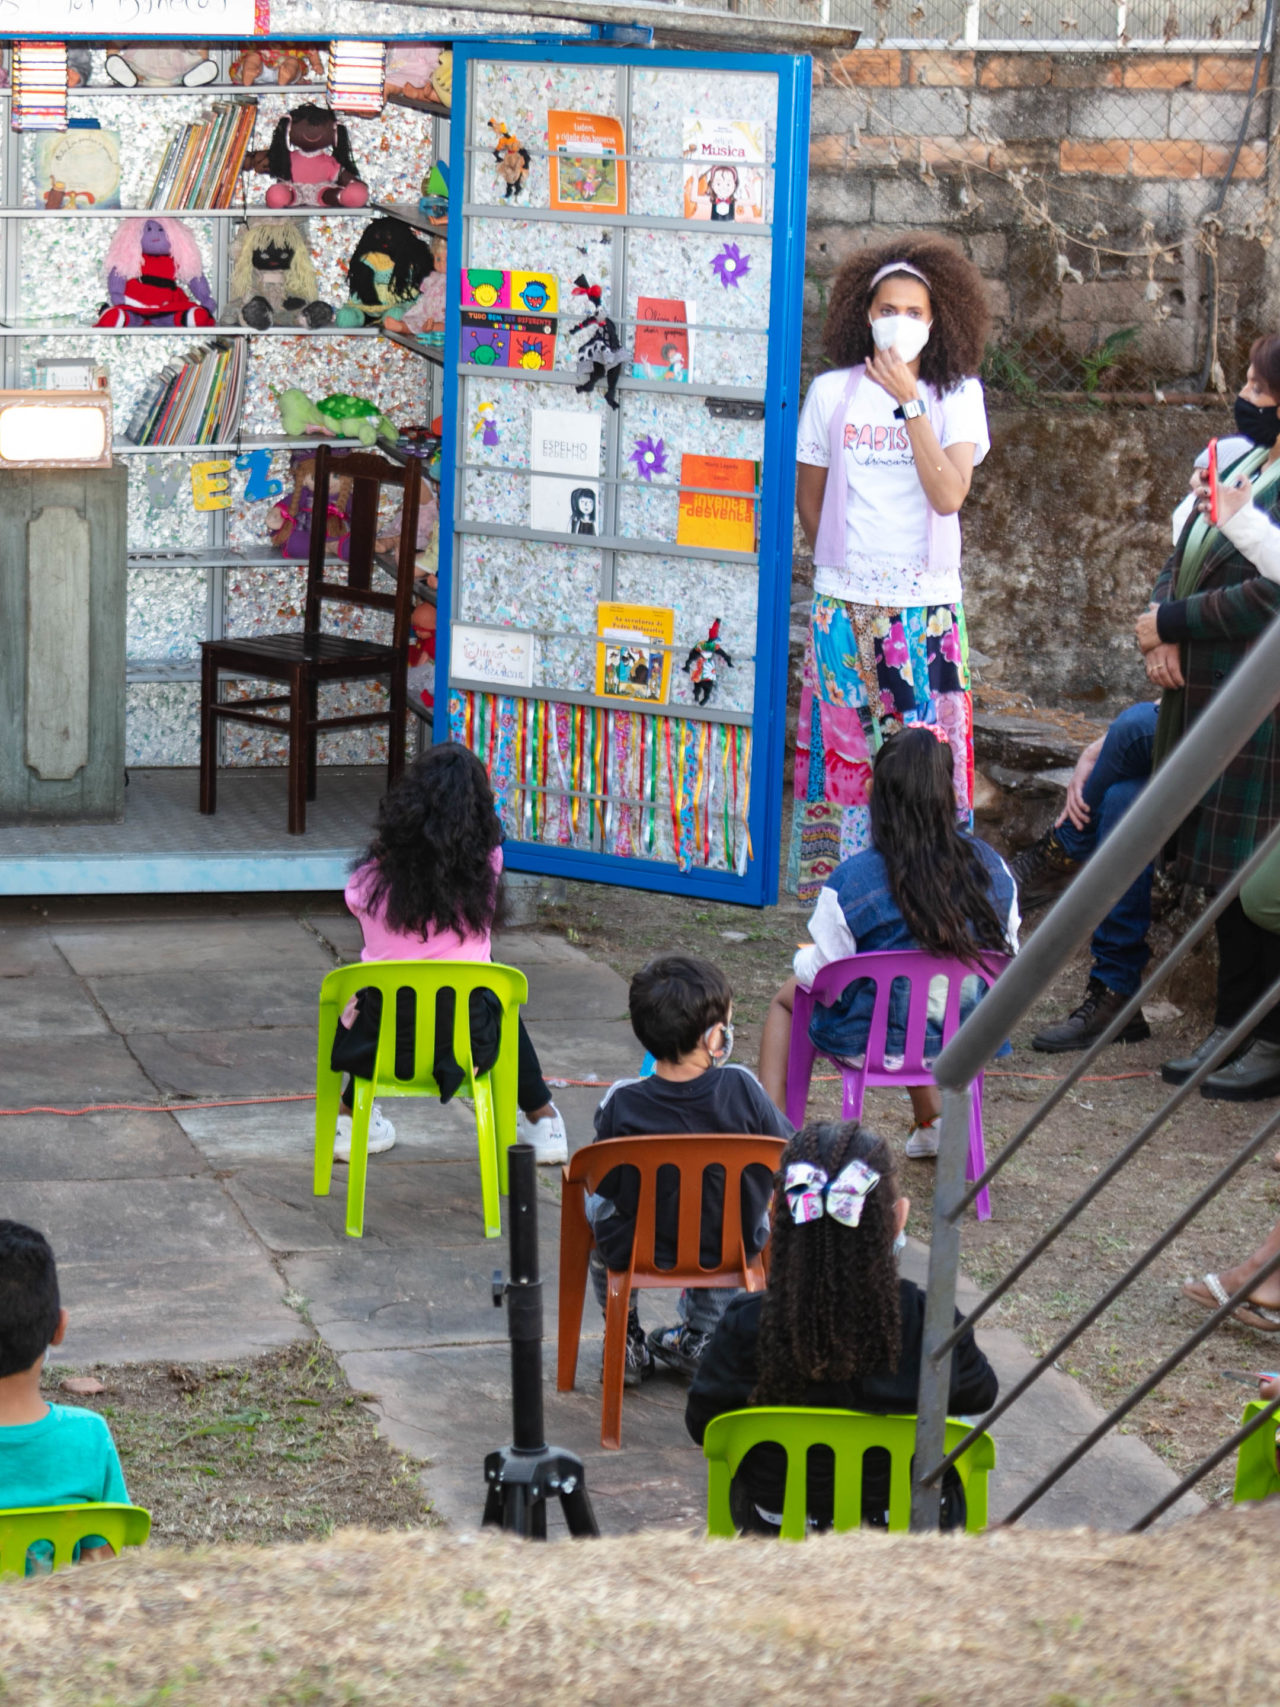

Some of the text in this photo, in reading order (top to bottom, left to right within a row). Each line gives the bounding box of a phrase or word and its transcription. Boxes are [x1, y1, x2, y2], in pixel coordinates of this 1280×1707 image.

[468, 311, 487, 321] TUDO
[542, 439, 588, 453] ESPELHO
[843, 423, 910, 452] RABIS
[694, 493, 747, 513] inventa
[686, 504, 753, 524] desventa
